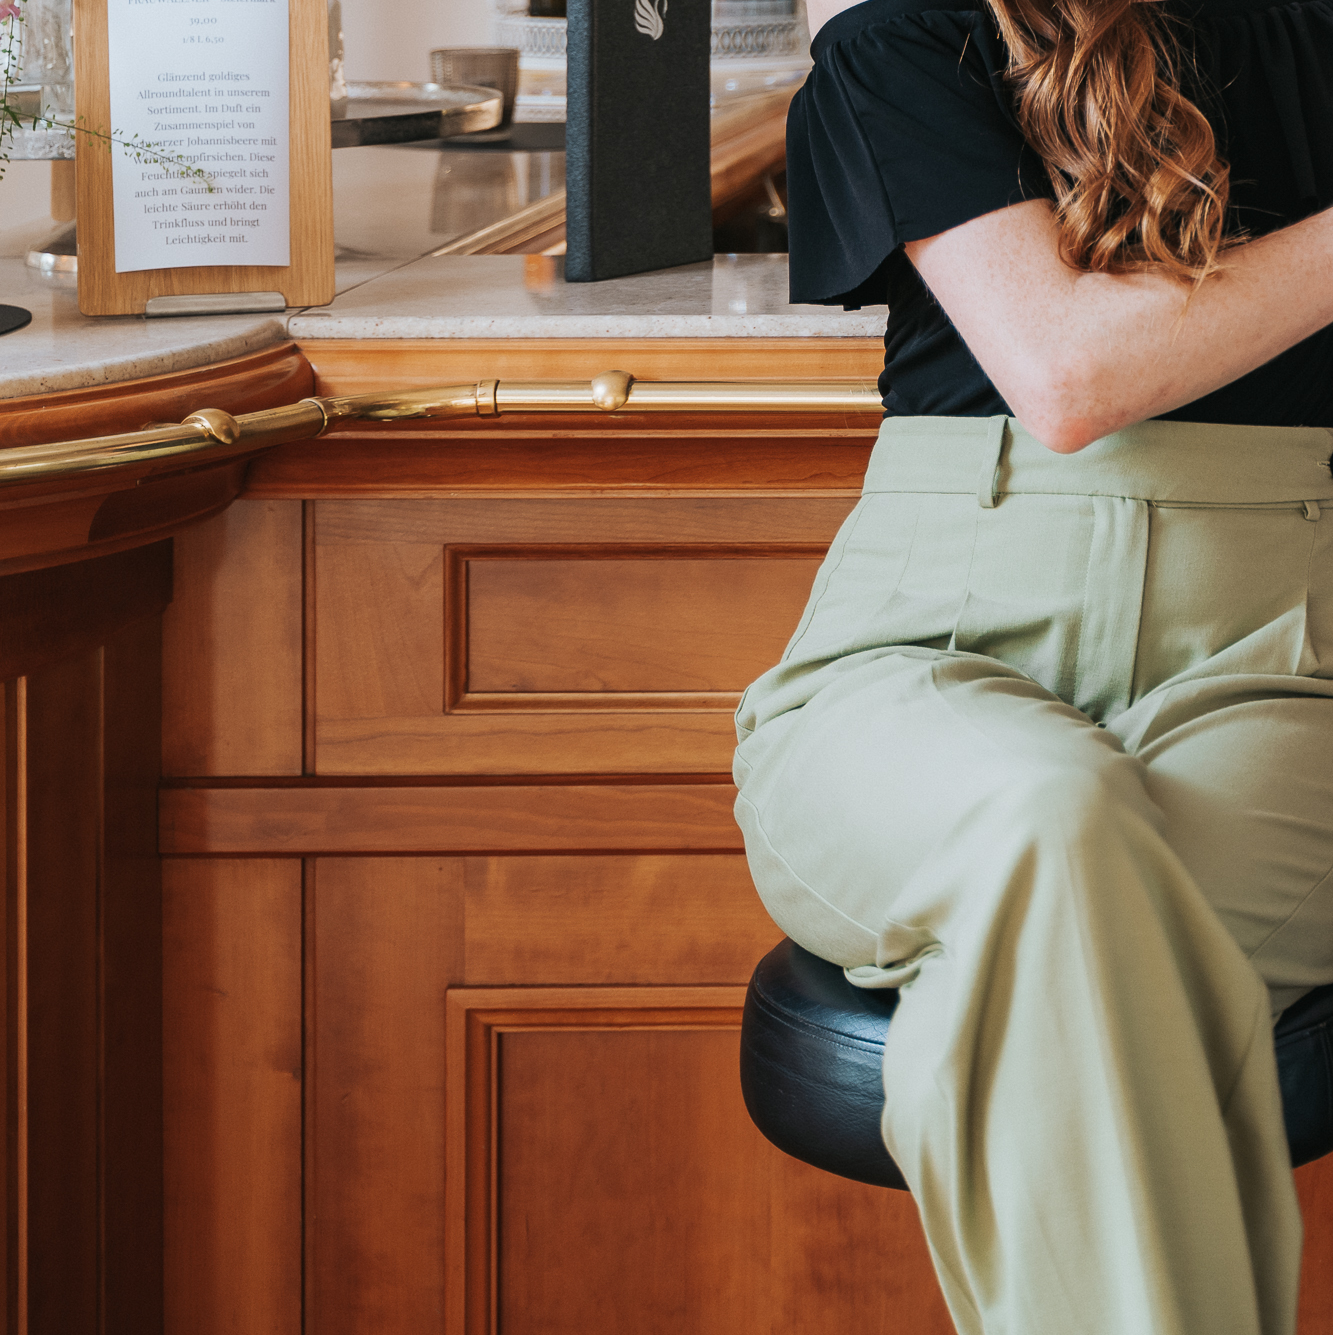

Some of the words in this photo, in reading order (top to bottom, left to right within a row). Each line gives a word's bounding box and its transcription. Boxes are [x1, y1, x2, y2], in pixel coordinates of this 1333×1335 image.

[157, 71, 206, 82] Glänzend
[208, 71, 250, 82] goldiges
[137, 87, 211, 100] Allroundtalent
[214, 87, 224, 97] in
[227, 89, 270, 97] unserem
[147, 105, 202, 115] Sortiment.
[205, 104, 218, 113] Im
[221, 103, 243, 113] Duft
[245, 103, 261, 113] ein
[154, 119, 234, 131] Zusammenspiel
[237, 120, 255, 129] von
[187, 136, 259, 147] Johannisbeere
[261, 136, 278, 146] mit
[249, 152, 276, 162] Diese
[208, 167, 247, 180] spiegelt
[249, 168, 269, 178] sich
[134, 187, 159, 198] auch
[161, 188, 178, 197] am
[225, 184, 257, 195] wider.
[259, 184, 276, 195] Die
[144, 203, 179, 214] leichte
[181, 201, 211, 212] Säure
[213, 200, 246, 211] erhöht
[249, 200, 268, 211] den
[152, 217, 205, 230] Trinkfluss
[207, 217, 228, 227] und
[230, 216, 261, 229] bringt
[165, 233, 227, 246] Leichtigkeit
[229, 233, 249, 244] mit.
